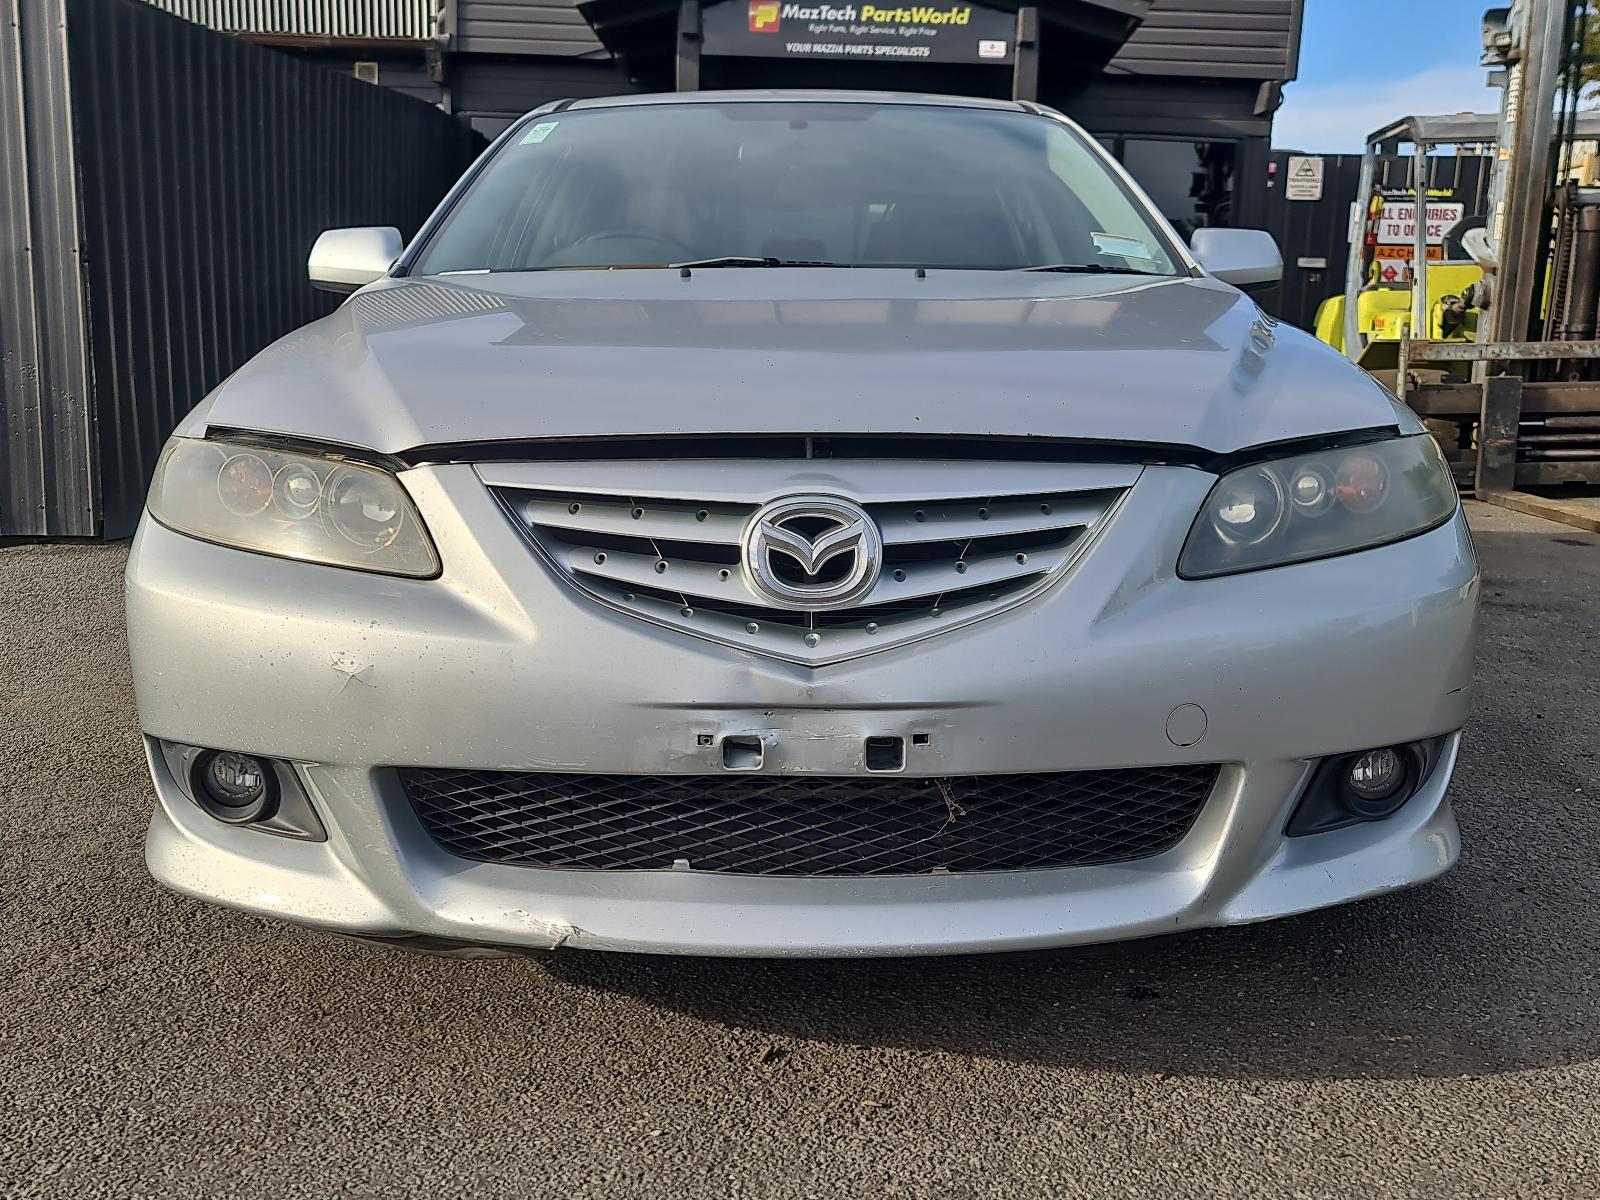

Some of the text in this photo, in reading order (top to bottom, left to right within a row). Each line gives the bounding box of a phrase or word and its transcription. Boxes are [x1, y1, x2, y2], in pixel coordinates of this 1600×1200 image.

[781, 3, 971, 25] MazTech PartsWorld
[785, 42, 931, 57] YOUR MAZDA PARTS SPECIALISTS
[1387, 224, 1400, 236] TO
